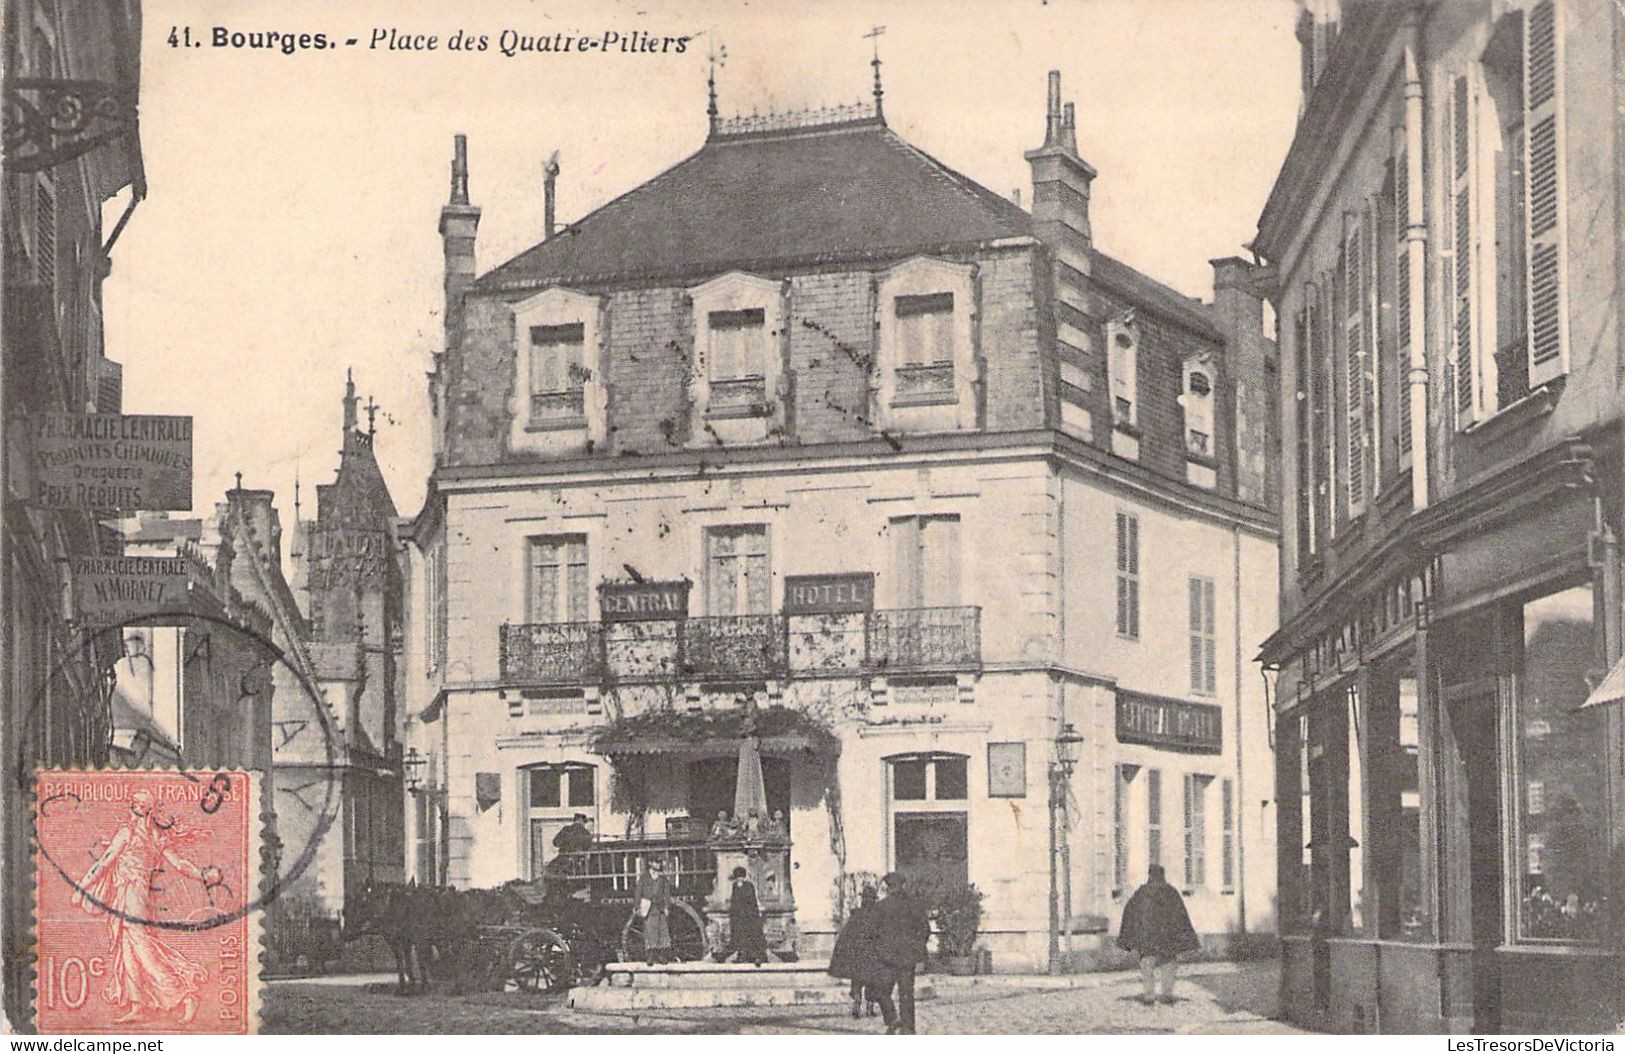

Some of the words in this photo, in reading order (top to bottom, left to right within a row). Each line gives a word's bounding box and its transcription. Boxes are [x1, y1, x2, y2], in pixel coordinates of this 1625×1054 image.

[37, 414, 117, 441] PHARMACIE
[120, 417, 192, 442] CENTRALE
[136, 558, 187, 576] CENTRALE
[605, 592, 680, 613] CENTRAL
[792, 583, 864, 606] HOTEL
[219, 934, 239, 1021] POSTES
